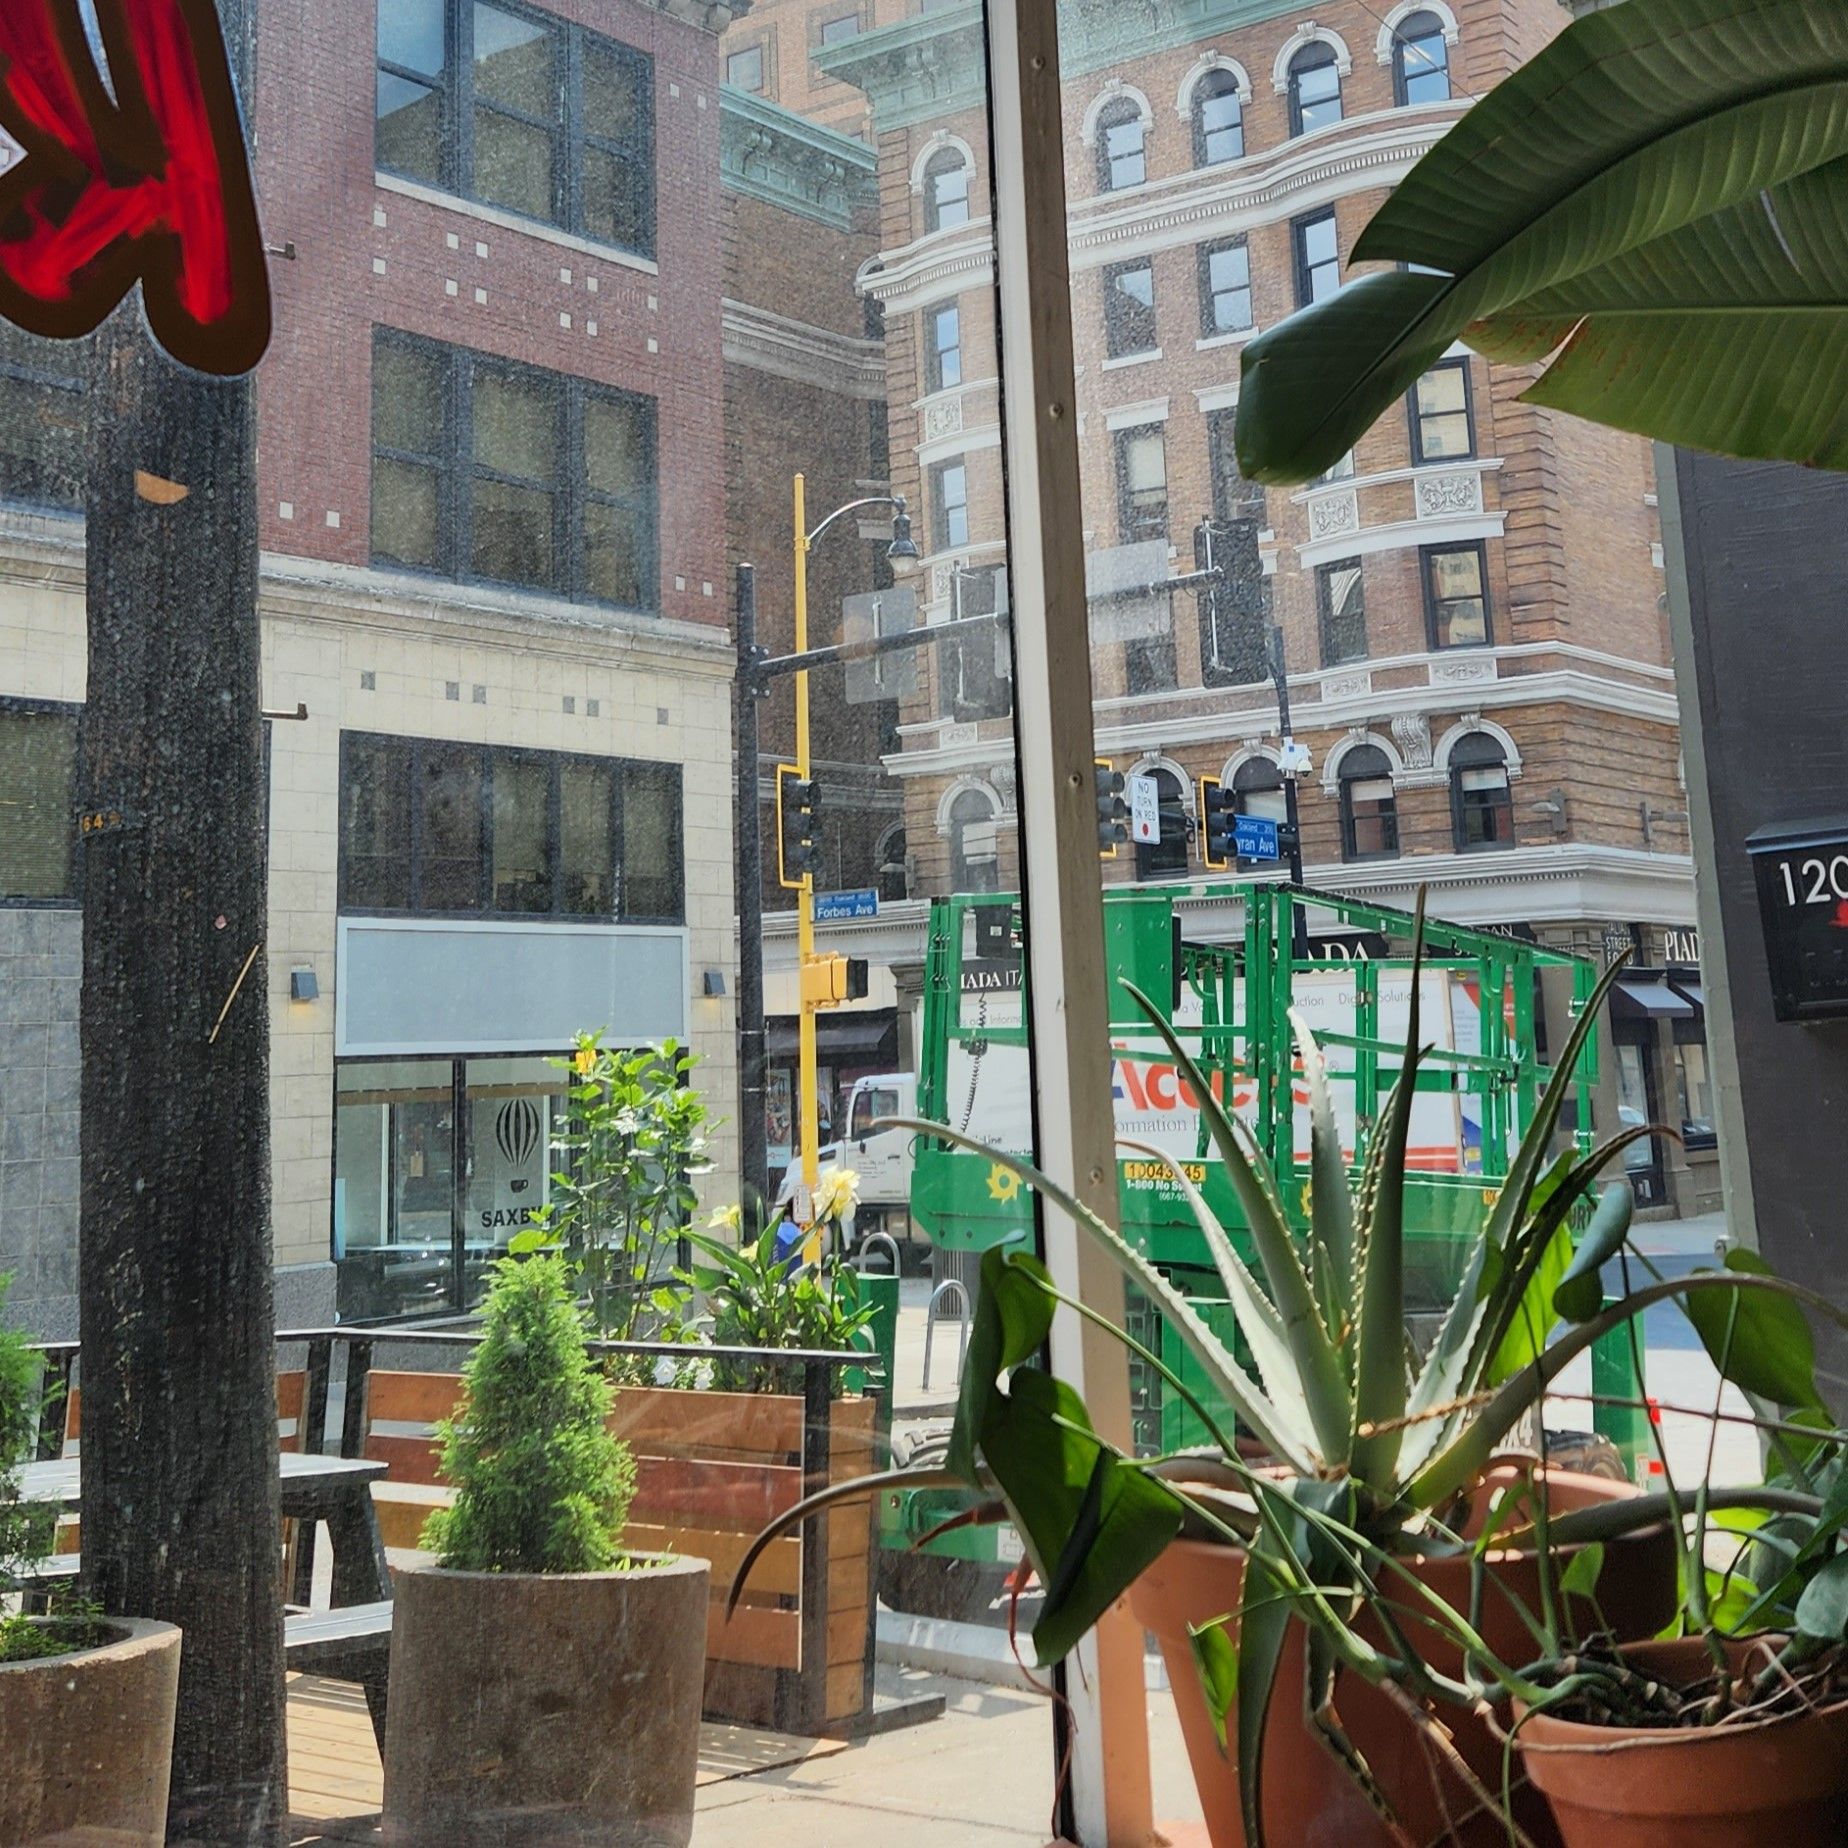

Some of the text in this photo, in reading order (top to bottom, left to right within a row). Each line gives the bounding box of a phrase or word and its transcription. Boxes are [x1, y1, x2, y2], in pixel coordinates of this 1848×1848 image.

[1137, 781, 1149, 794] NO
[1258, 836, 1275, 854] Ave
[817, 903, 874, 918] Forbes Ave
[1606, 950, 1634, 966] FOD
[1155, 1181, 1170, 1191] No
[481, 1204, 553, 1228] SAXB
